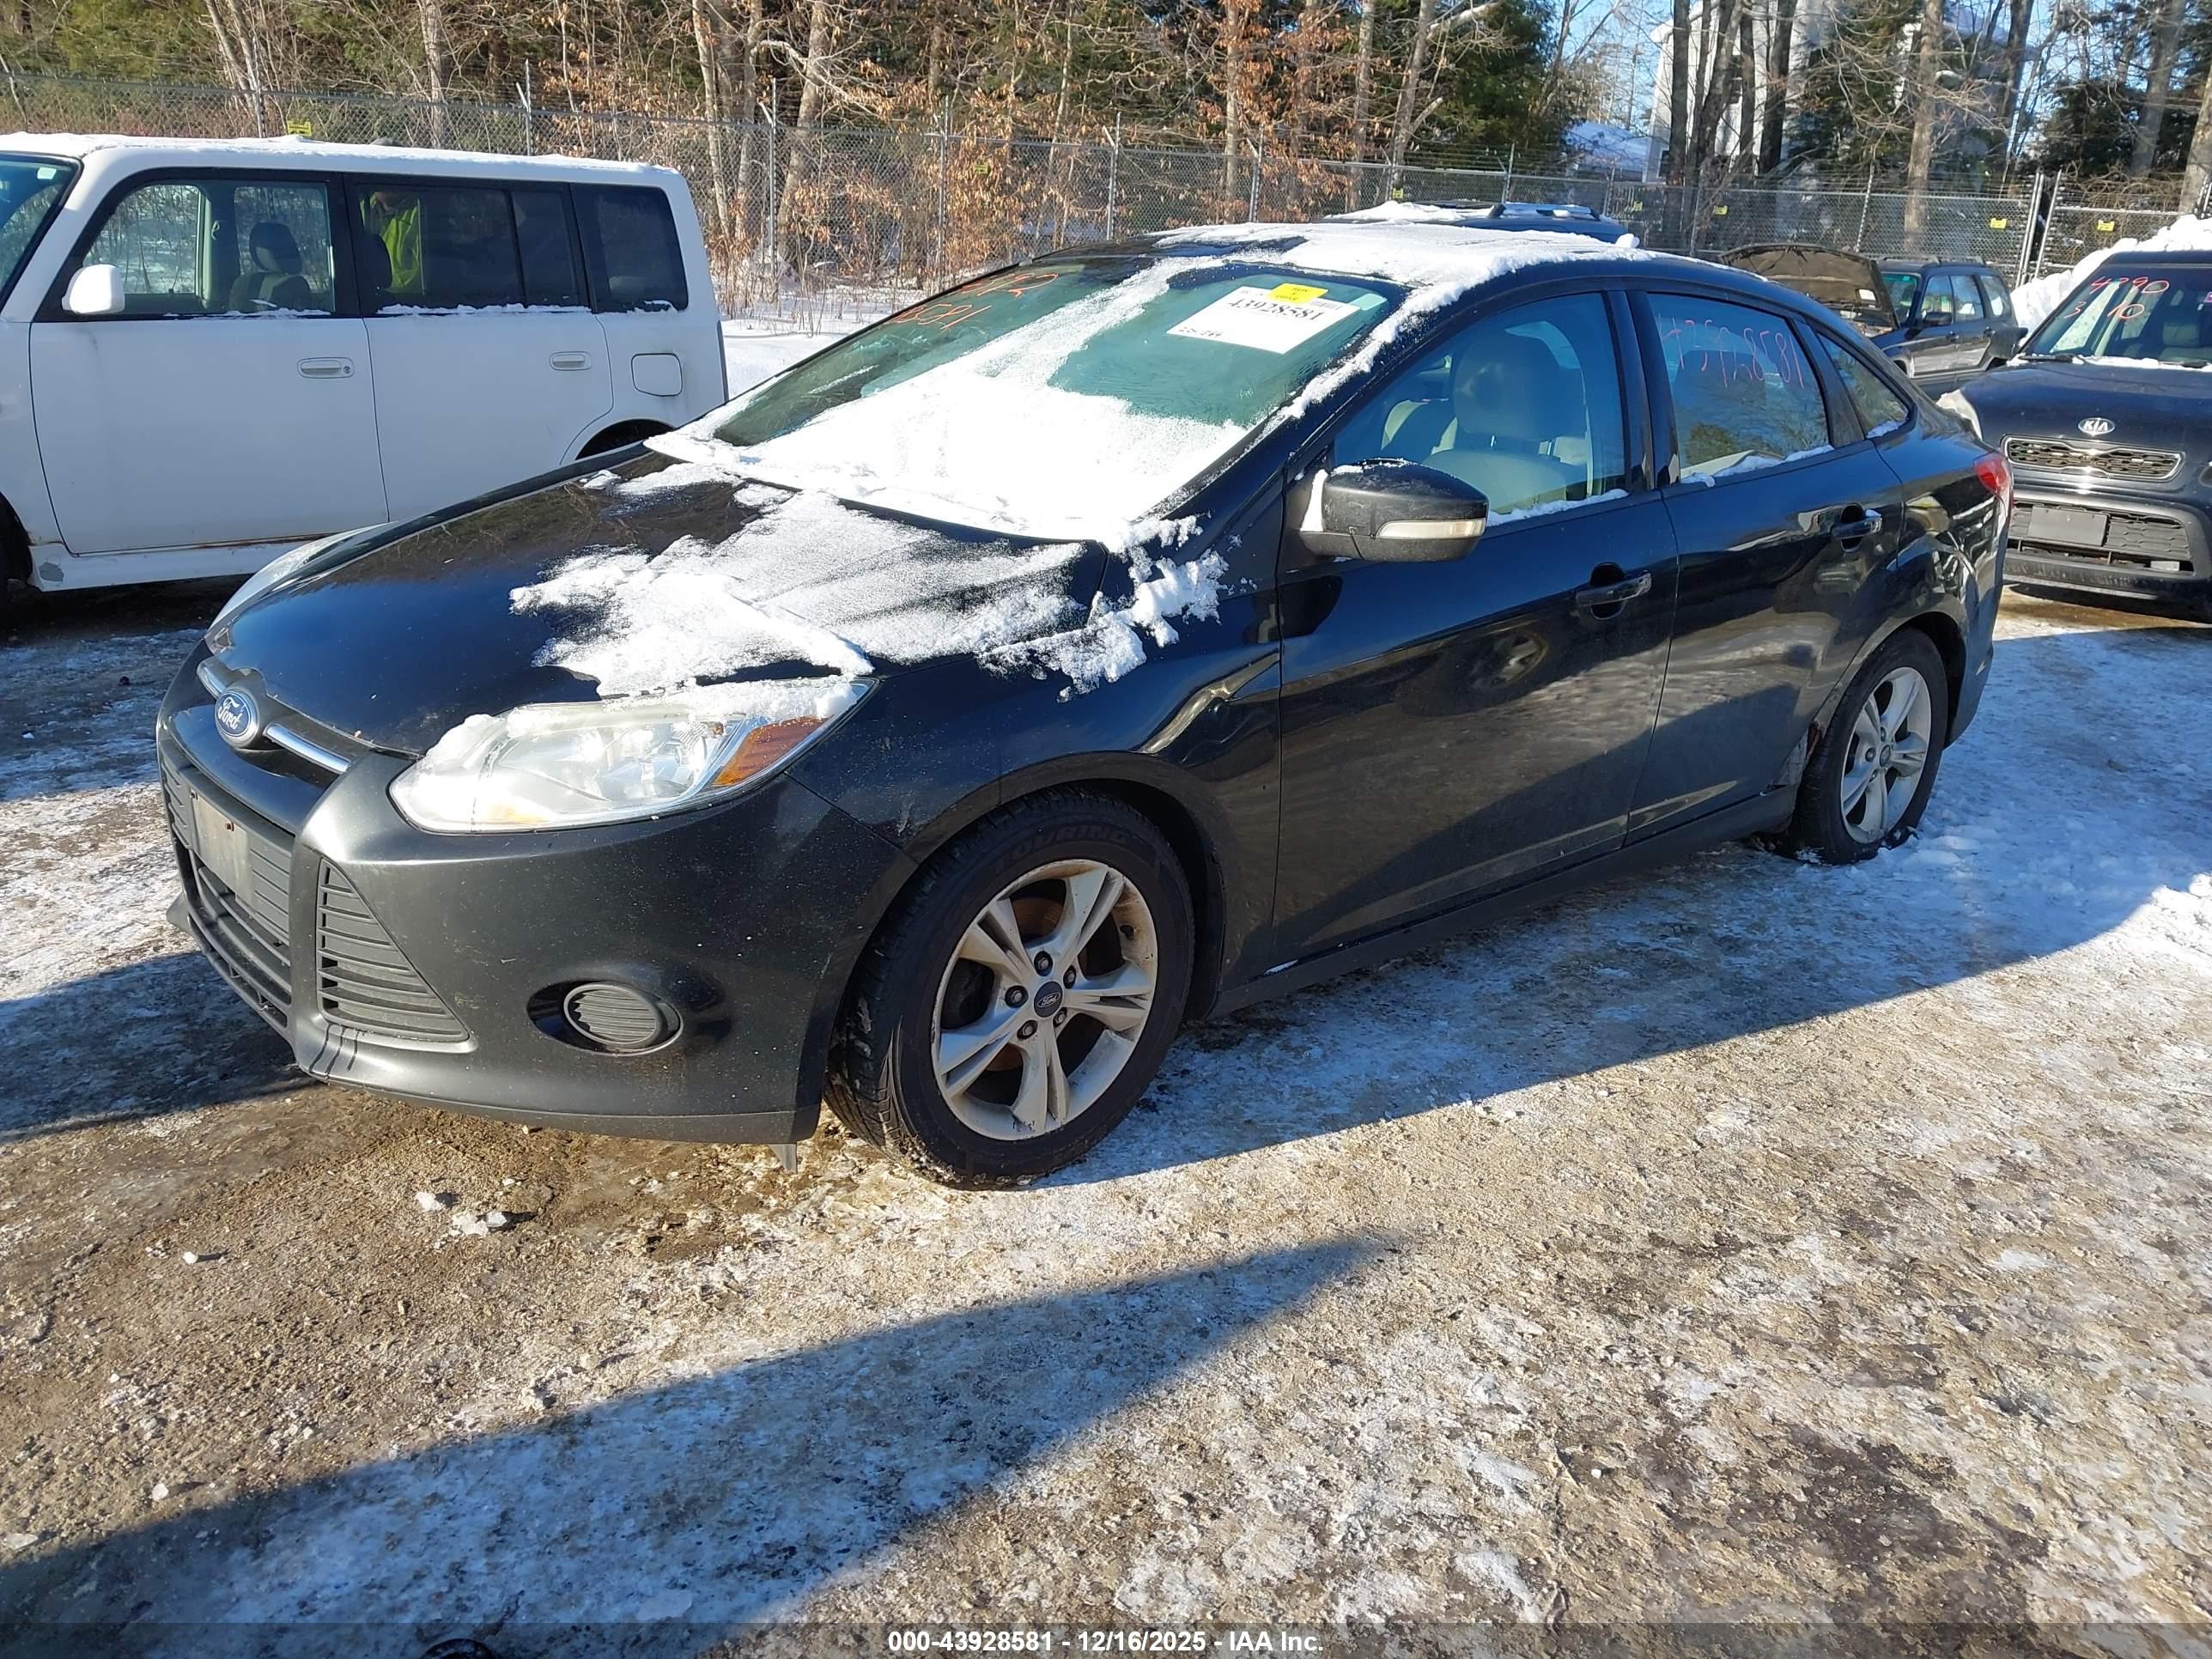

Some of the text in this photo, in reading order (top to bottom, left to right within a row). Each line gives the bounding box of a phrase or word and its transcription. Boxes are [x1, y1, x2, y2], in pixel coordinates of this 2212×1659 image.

[1227, 297, 1325, 321] 43928581
[2083, 419, 2109, 432] KIA
[217, 696, 243, 730] Ford
[1041, 994, 1058, 1006] Ford
